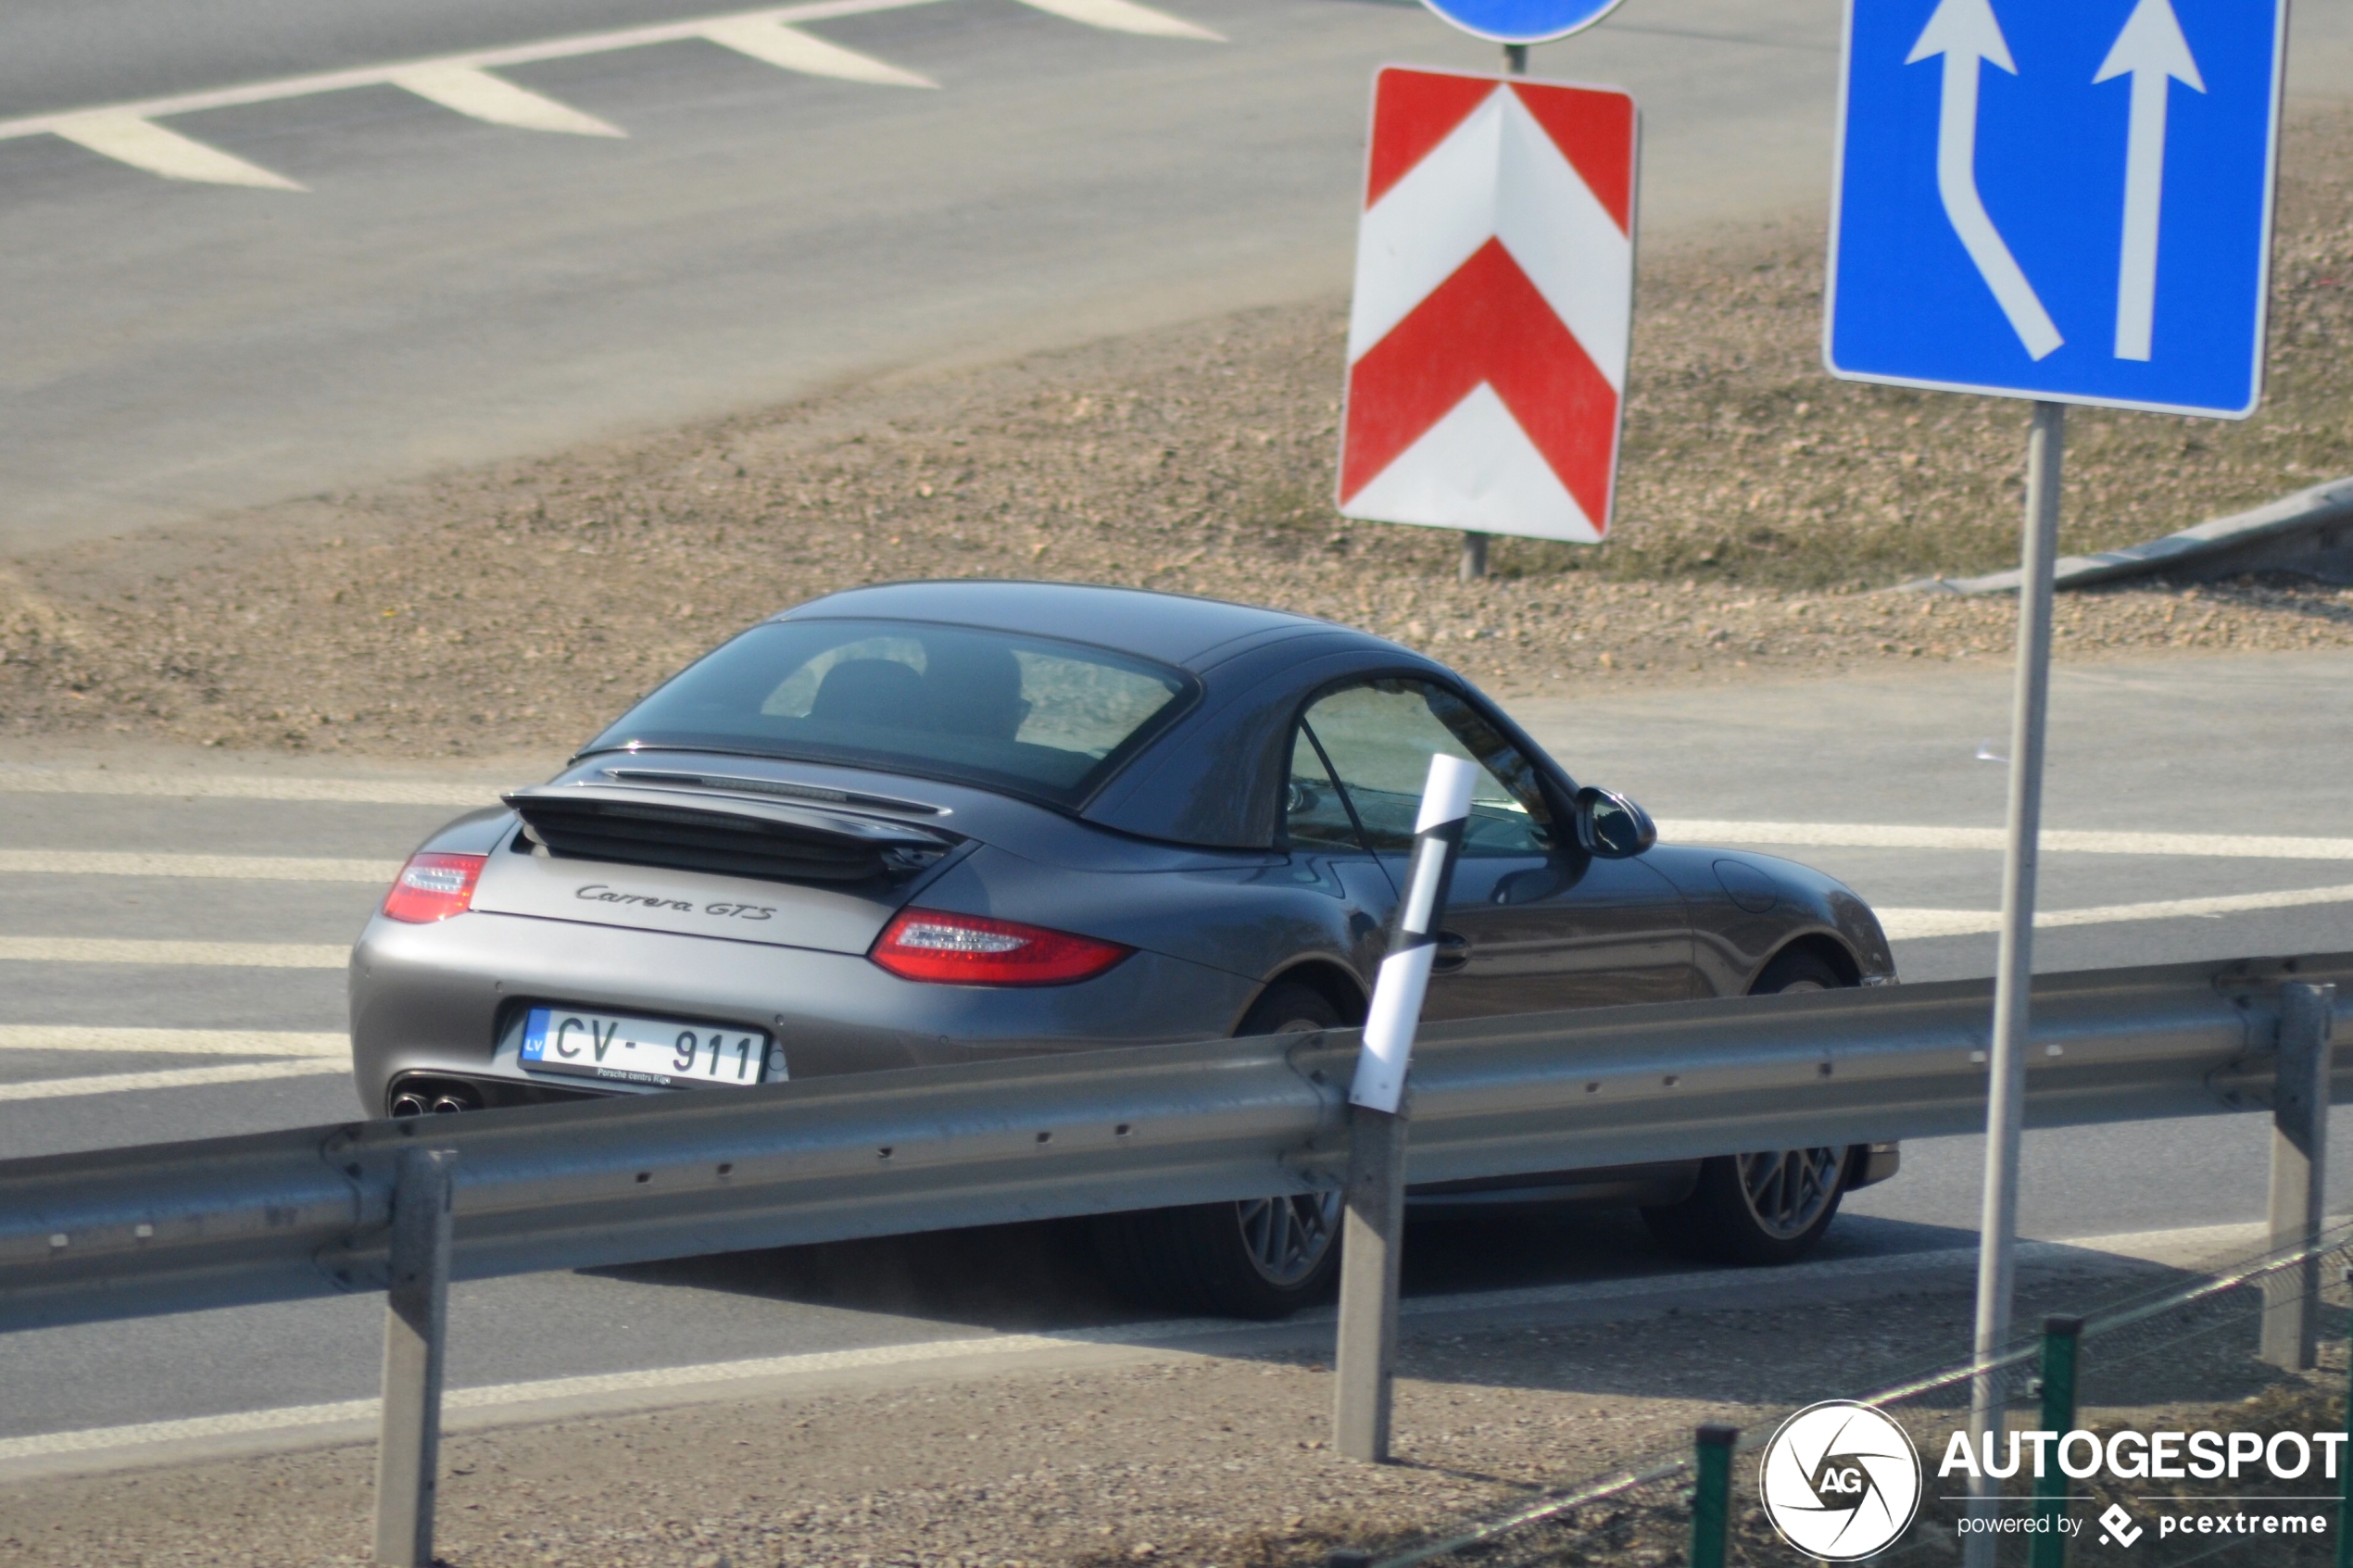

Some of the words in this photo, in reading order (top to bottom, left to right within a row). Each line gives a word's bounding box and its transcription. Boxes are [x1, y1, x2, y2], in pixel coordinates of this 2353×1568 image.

[575, 884, 693, 912] Carrera
[705, 902, 777, 920] GTS
[525, 1039, 544, 1052] LV
[673, 1031, 751, 1080] 911
[598, 1067, 627, 1079] Porsche
[628, 1073, 652, 1082] centrs
